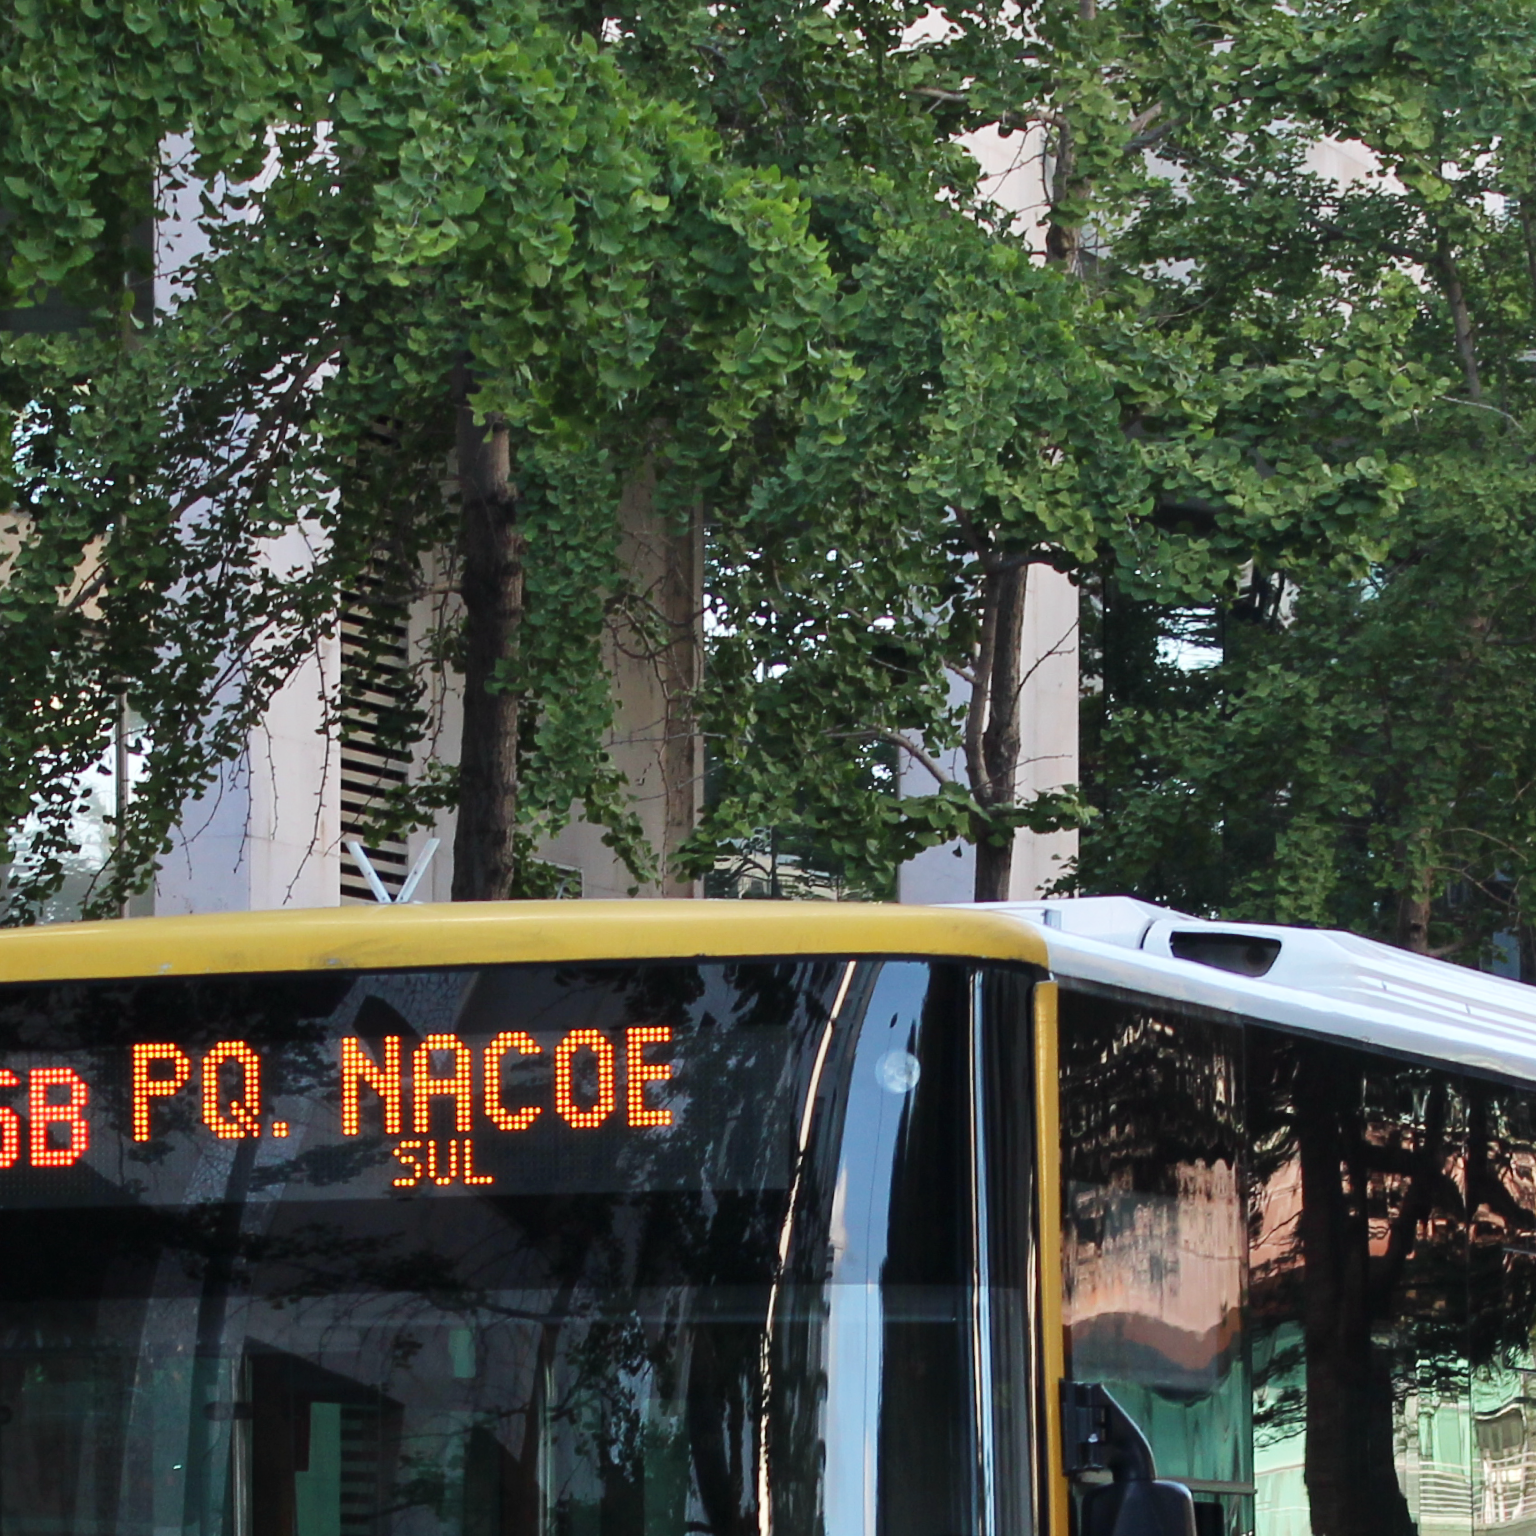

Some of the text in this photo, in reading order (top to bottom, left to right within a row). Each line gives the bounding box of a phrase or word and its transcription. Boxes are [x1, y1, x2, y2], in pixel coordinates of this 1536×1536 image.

[132, 1026, 673, 1143] PQ. NACOE
[392, 1138, 494, 1187] SUL
